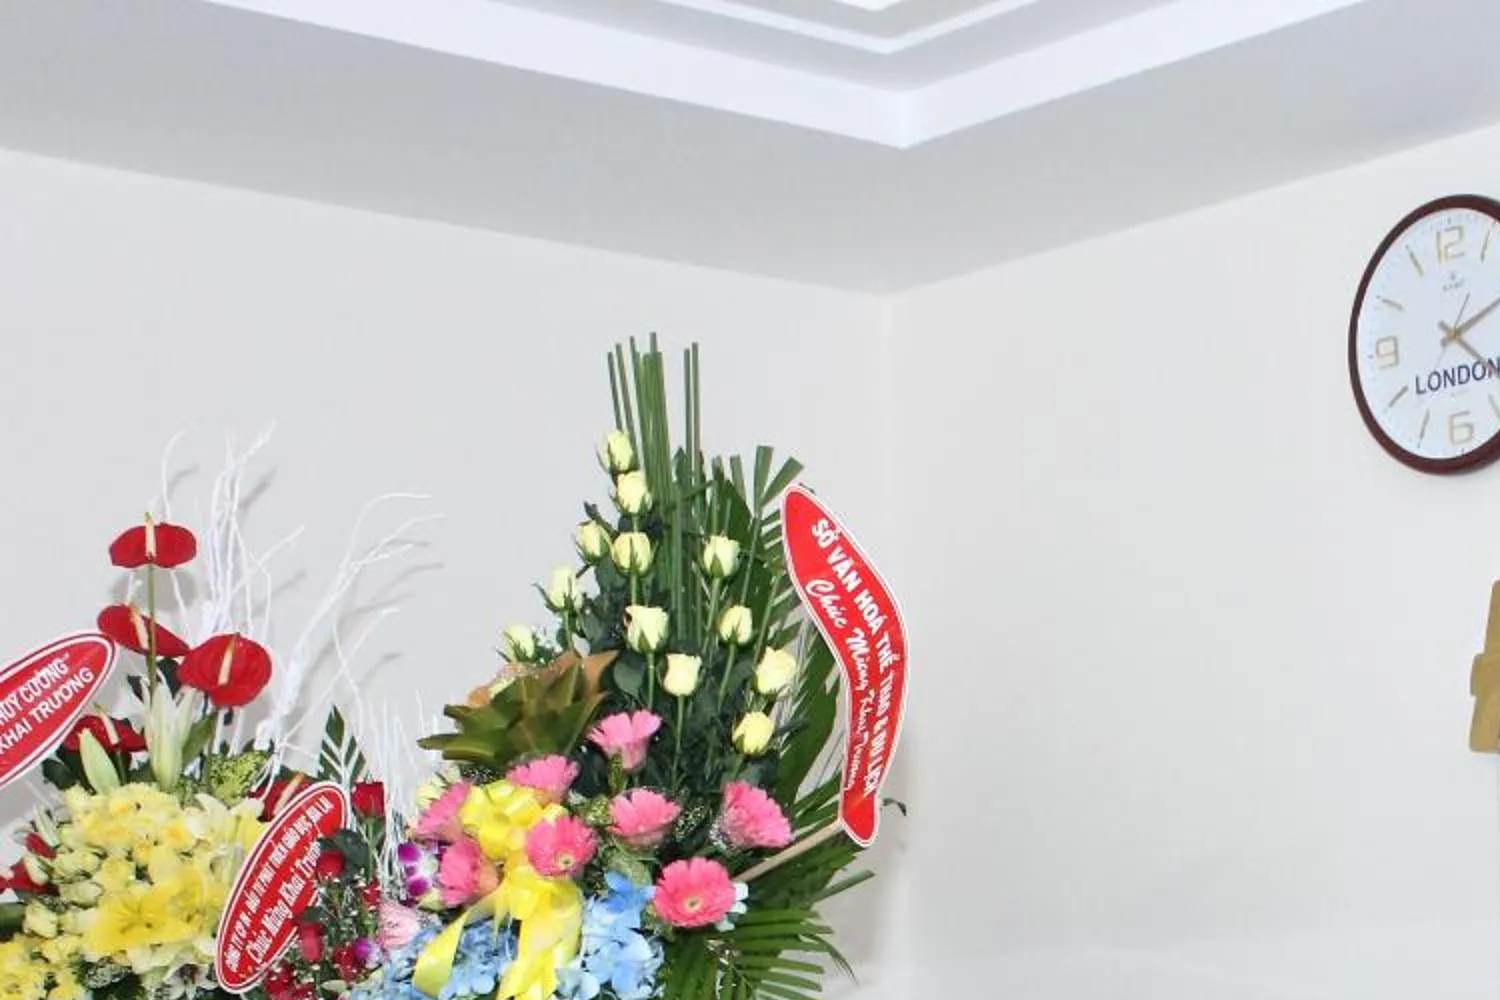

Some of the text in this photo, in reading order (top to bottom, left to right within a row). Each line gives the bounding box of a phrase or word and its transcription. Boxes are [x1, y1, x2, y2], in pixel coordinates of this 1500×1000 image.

[1435, 225, 1466, 263] 12
[1375, 335, 1399, 370] 9
[1447, 410, 1475, 445] 6
